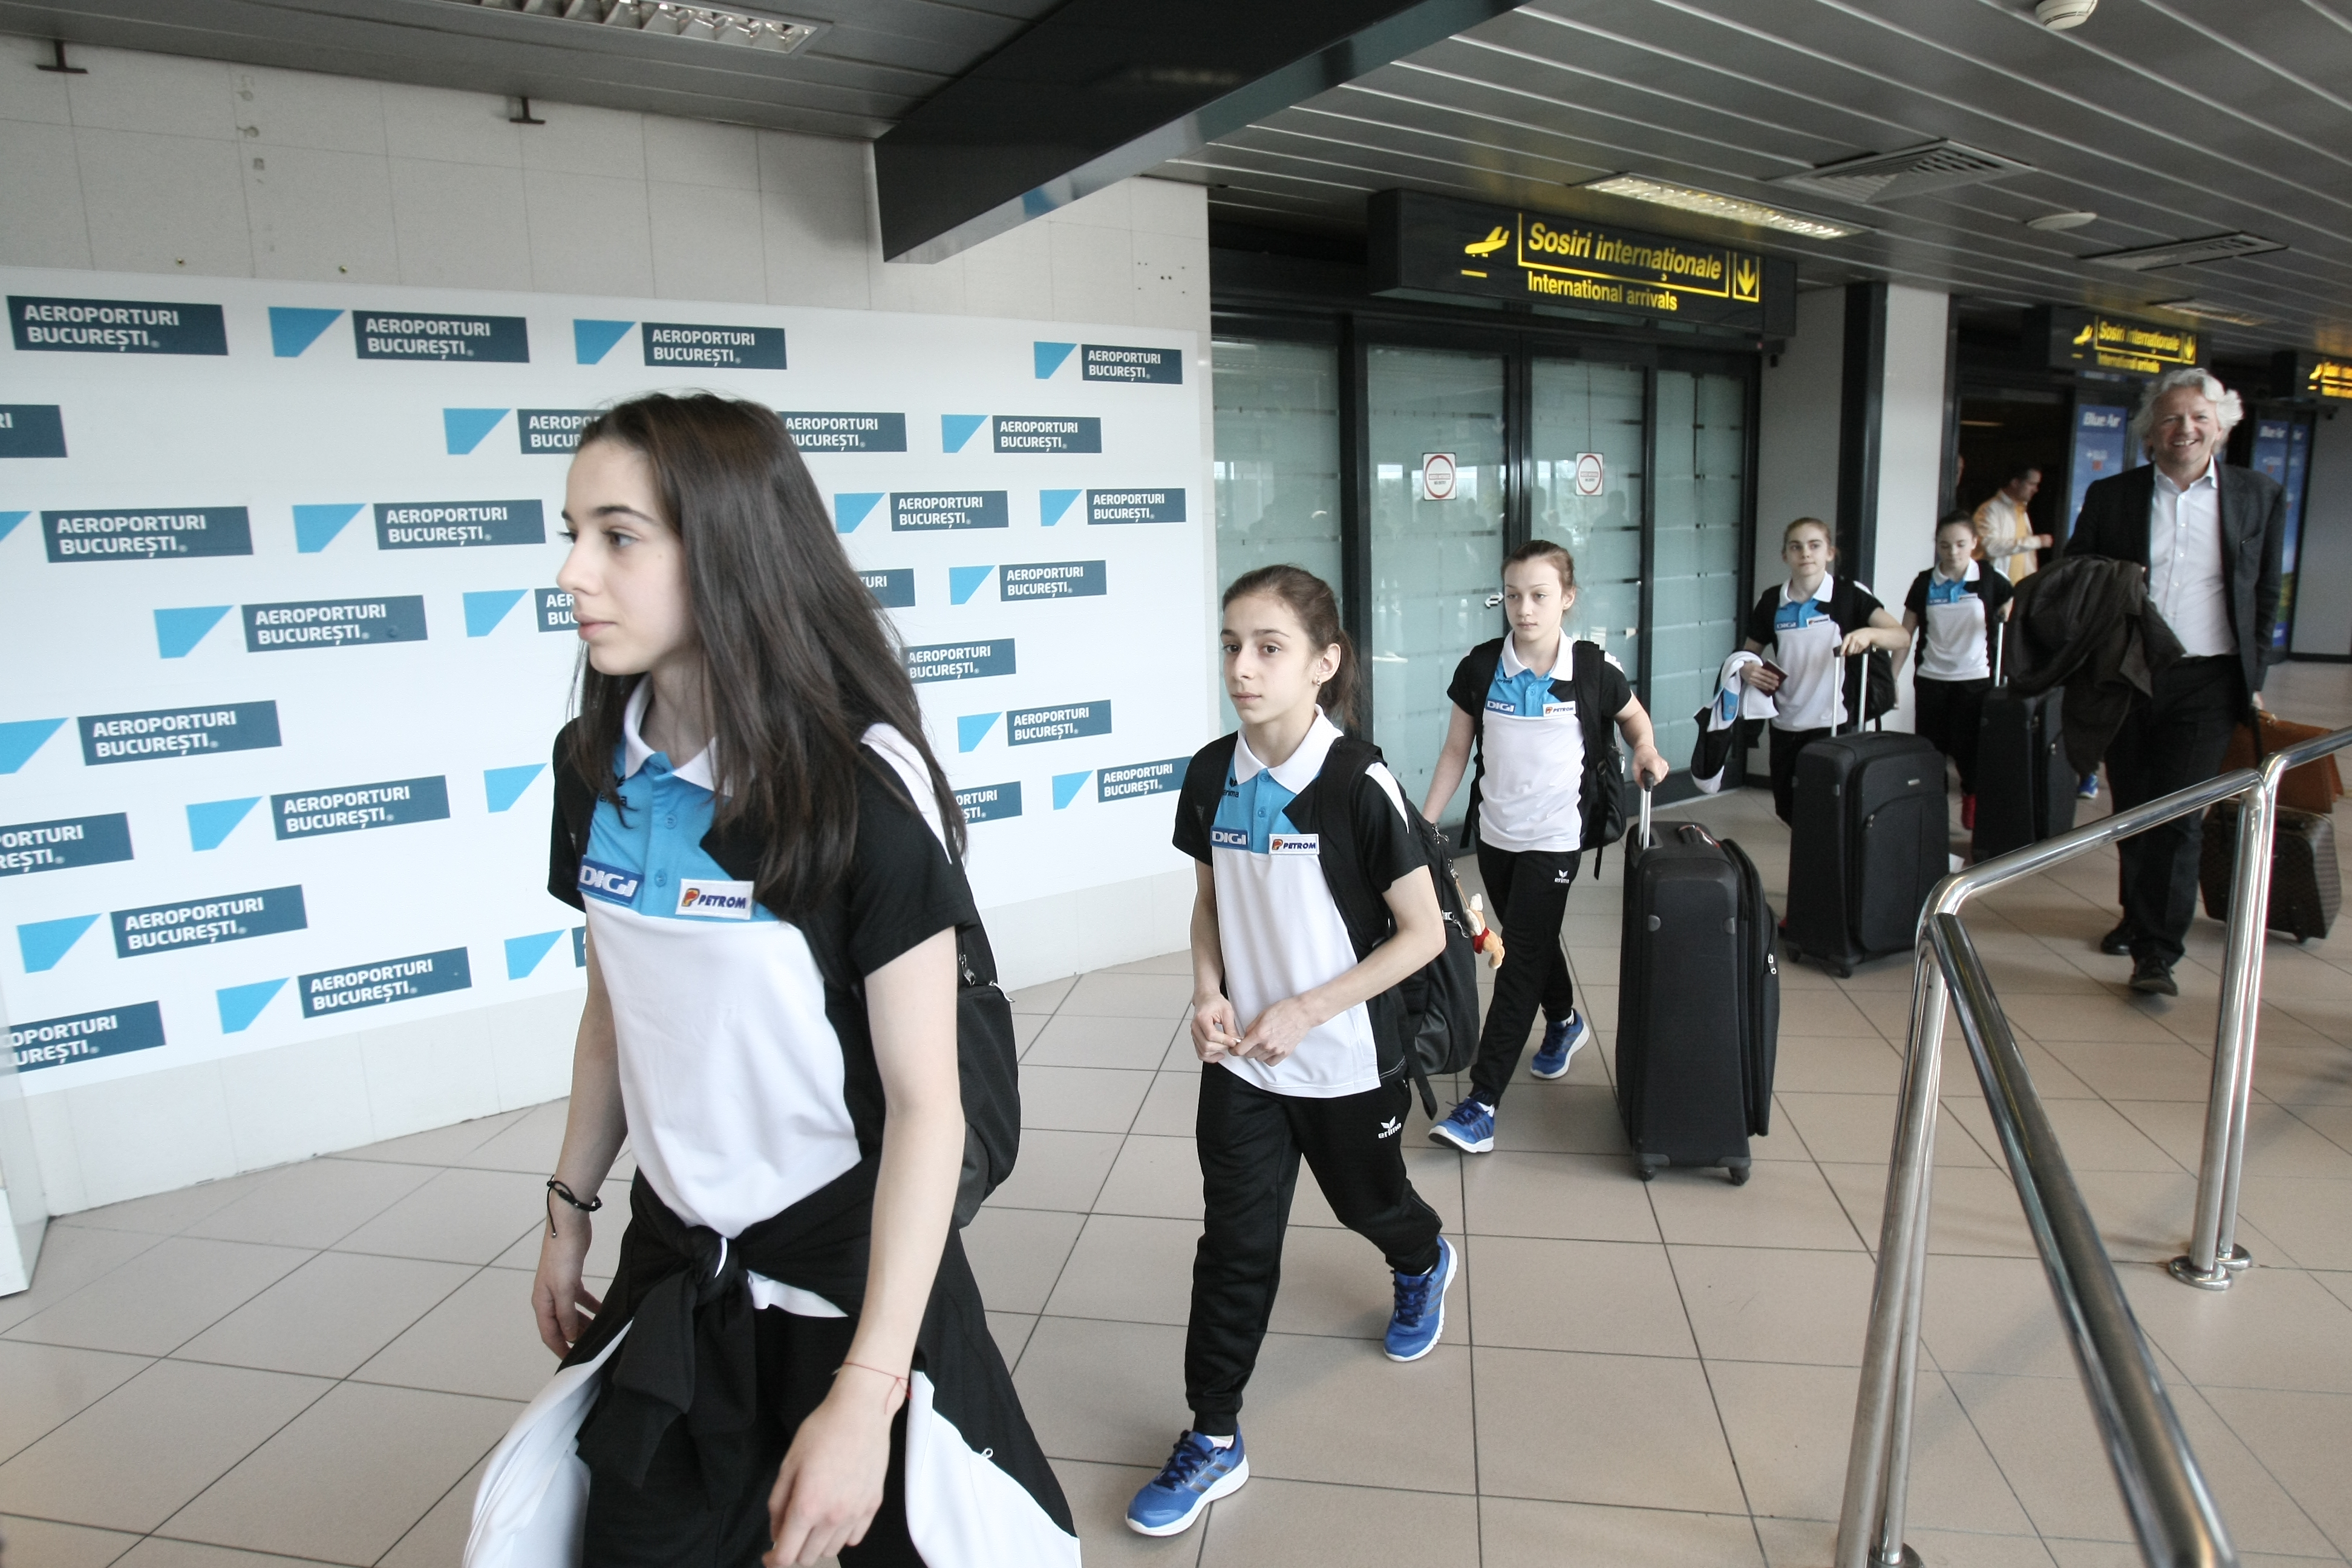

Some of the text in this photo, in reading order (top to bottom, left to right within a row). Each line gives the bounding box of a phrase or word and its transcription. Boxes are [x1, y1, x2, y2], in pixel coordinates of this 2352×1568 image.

[1528, 223, 1592, 258] Sosiri
[1528, 271, 1677, 311] International arrivals
[25, 305, 179, 326] AEROPORTURI
[366, 318, 490, 336] AEROPORTURI
[653, 330, 754, 345] AEROPORTURI
[1088, 350, 1160, 364] AEROPORTURI
[529, 416, 599, 429] AEROPO
[786, 417, 878, 430] AEROPORTURI
[1000, 421, 1078, 434] AEROPORTURI
[531, 434, 581, 447] BUCUR
[898, 496, 982, 509] AEROPORTURI
[1093, 494, 1165, 506] AEROPORTURI
[57, 515, 206, 534] AEROPORTURI
[386, 507, 508, 524] AEROPORTURI
[1007, 566, 1083, 580] AEROPORTURI
[255, 604, 386, 626] AEROPORTURI
[908, 645, 991, 664] AEROPORTURI
[910, 662, 973, 679] BUCUREȘTI
[1486, 700, 1515, 713] DIGI
[93, 711, 237, 737] AEROPORTURI
[1013, 707, 1089, 726] AEROPORTURI
[1103, 763, 1172, 783] AEROPORTURI
[283, 786, 410, 814] AEROPORTURI
[956, 789, 998, 805] ORTURI
[0, 825, 84, 848] ORTURI
[1212, 830, 1247, 846] DIGI
[579, 865, 638, 898] DIGI
[697, 893, 746, 909] PETROM
[125, 897, 264, 932] AEROPORTURI
[310, 958, 433, 993] AEROPORTURI
[11, 1015, 118, 1047] OPORTURI
